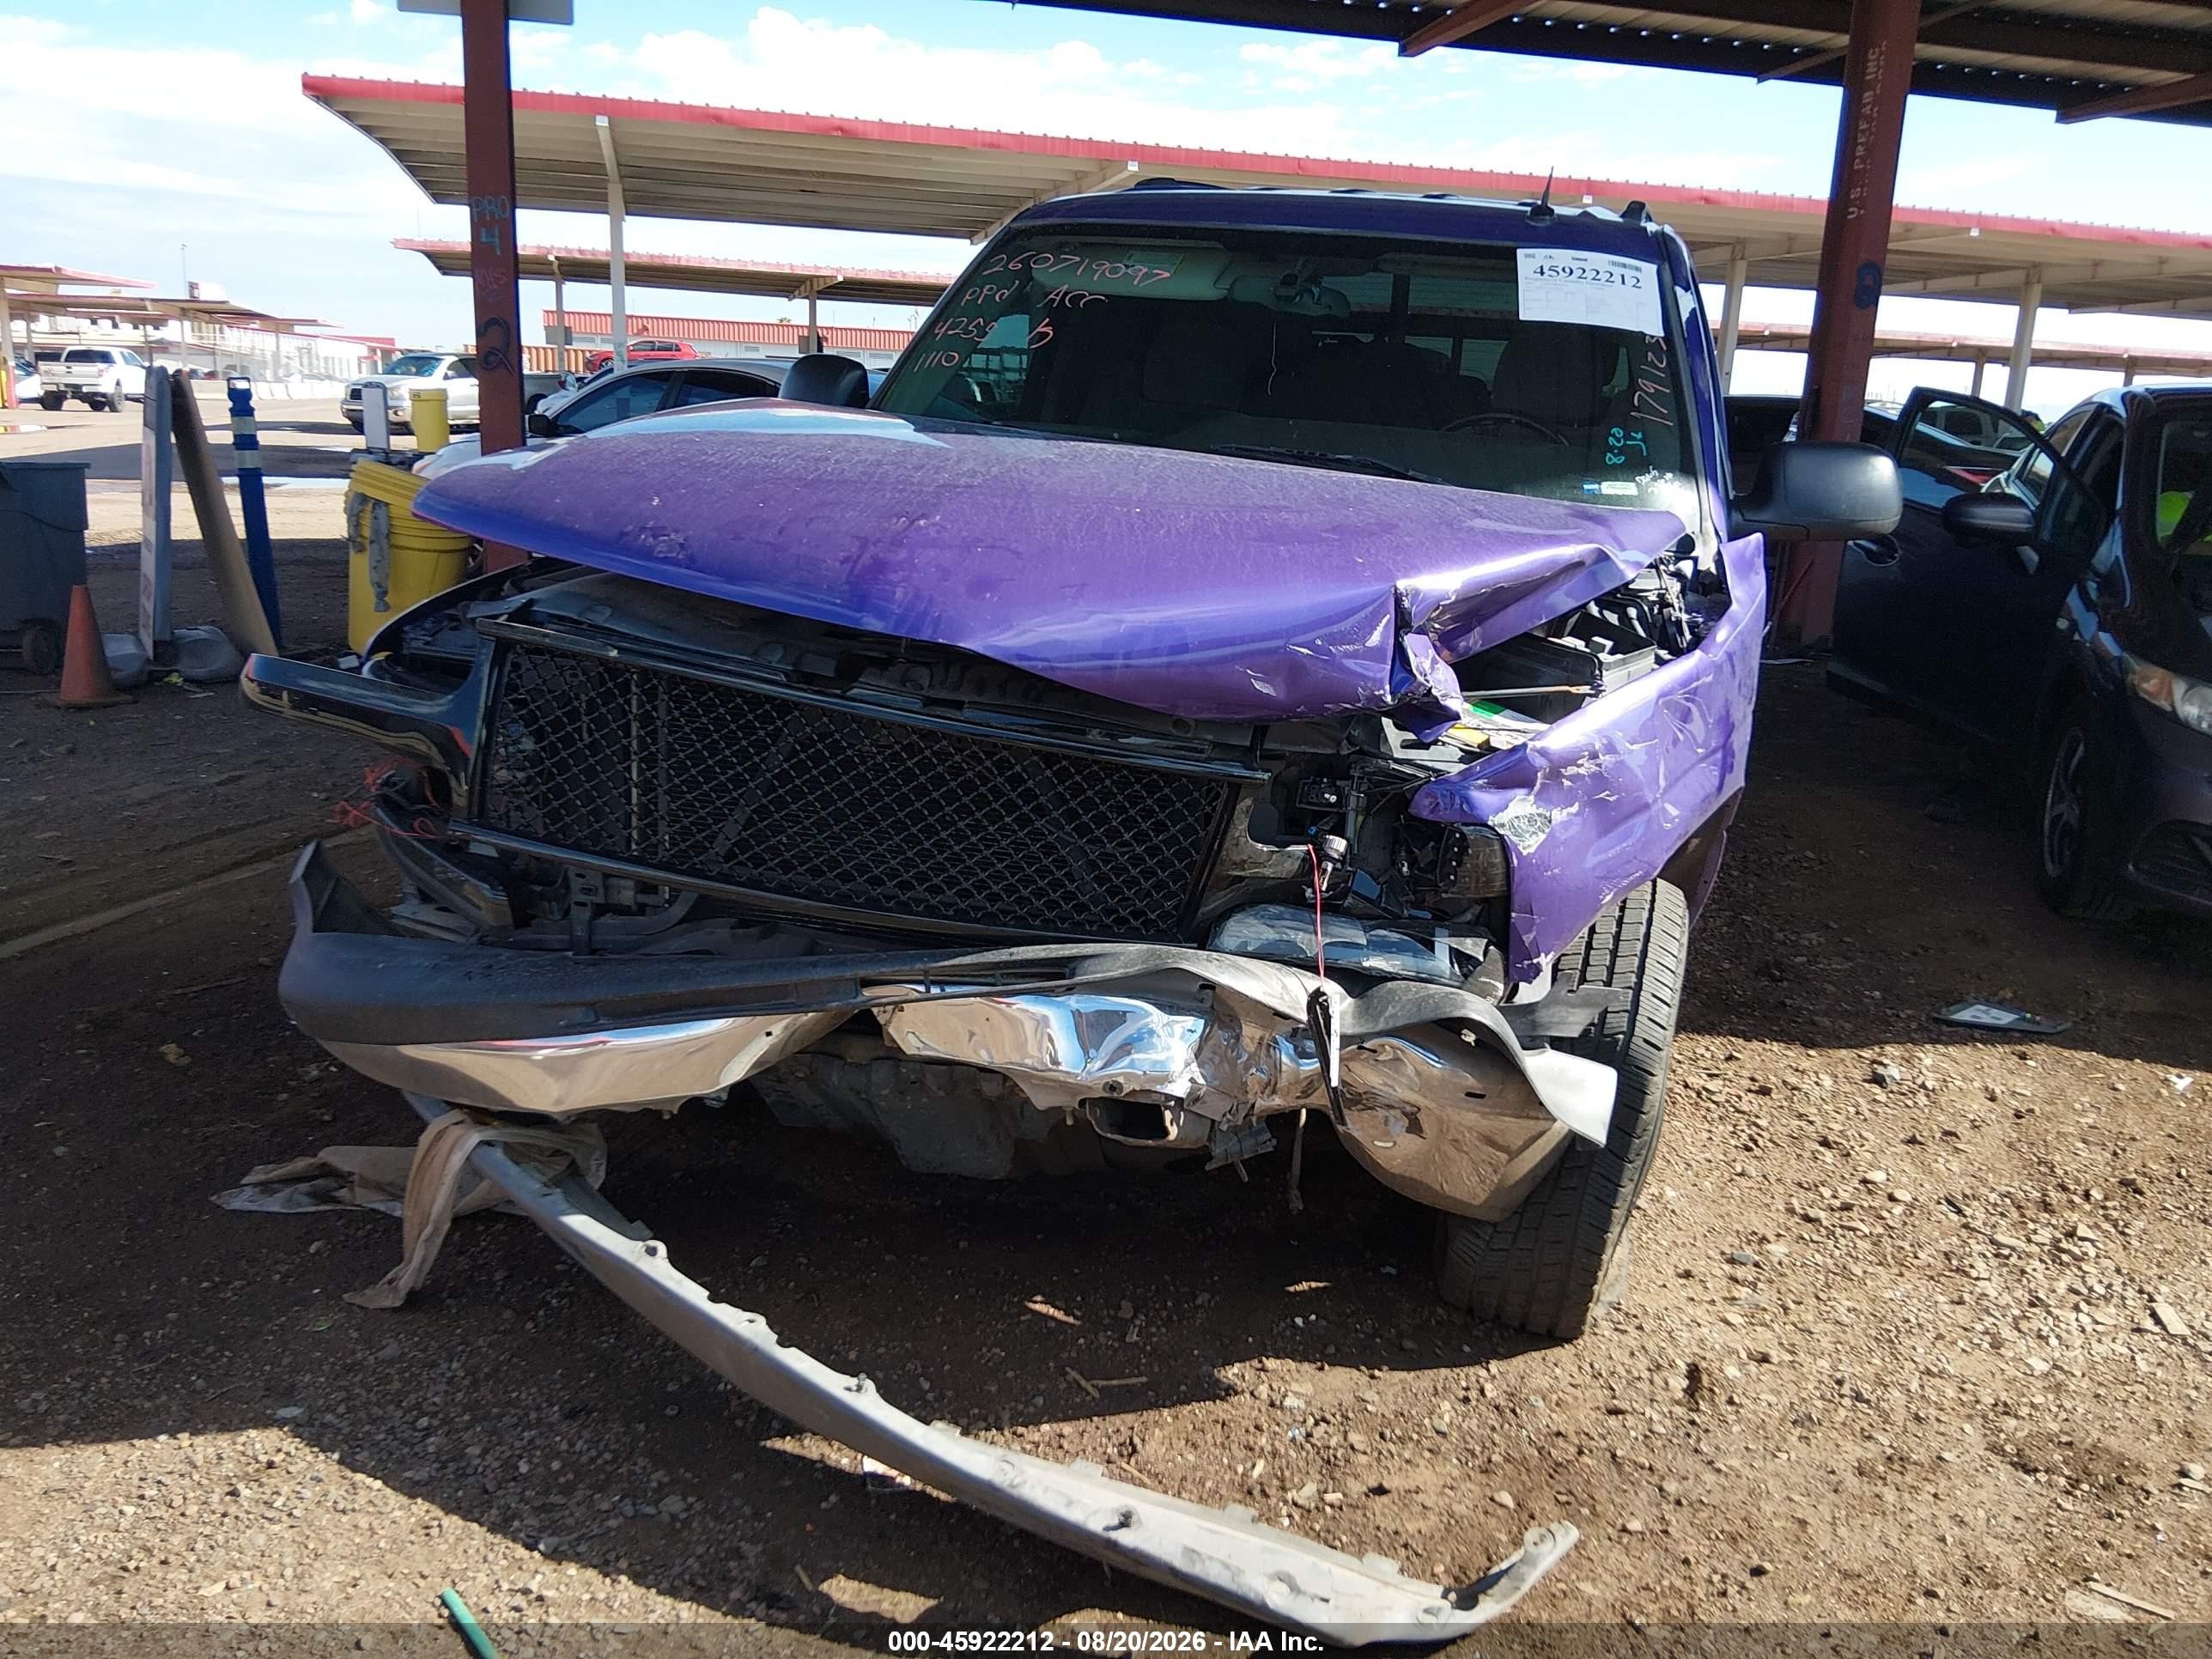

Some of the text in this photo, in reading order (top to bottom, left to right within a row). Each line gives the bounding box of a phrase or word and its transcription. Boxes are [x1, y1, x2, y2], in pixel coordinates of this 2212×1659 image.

[481, 226, 501, 256] 4
[983, 252, 1172, 286] 260719097
[1533, 264, 1642, 289] 45922212
